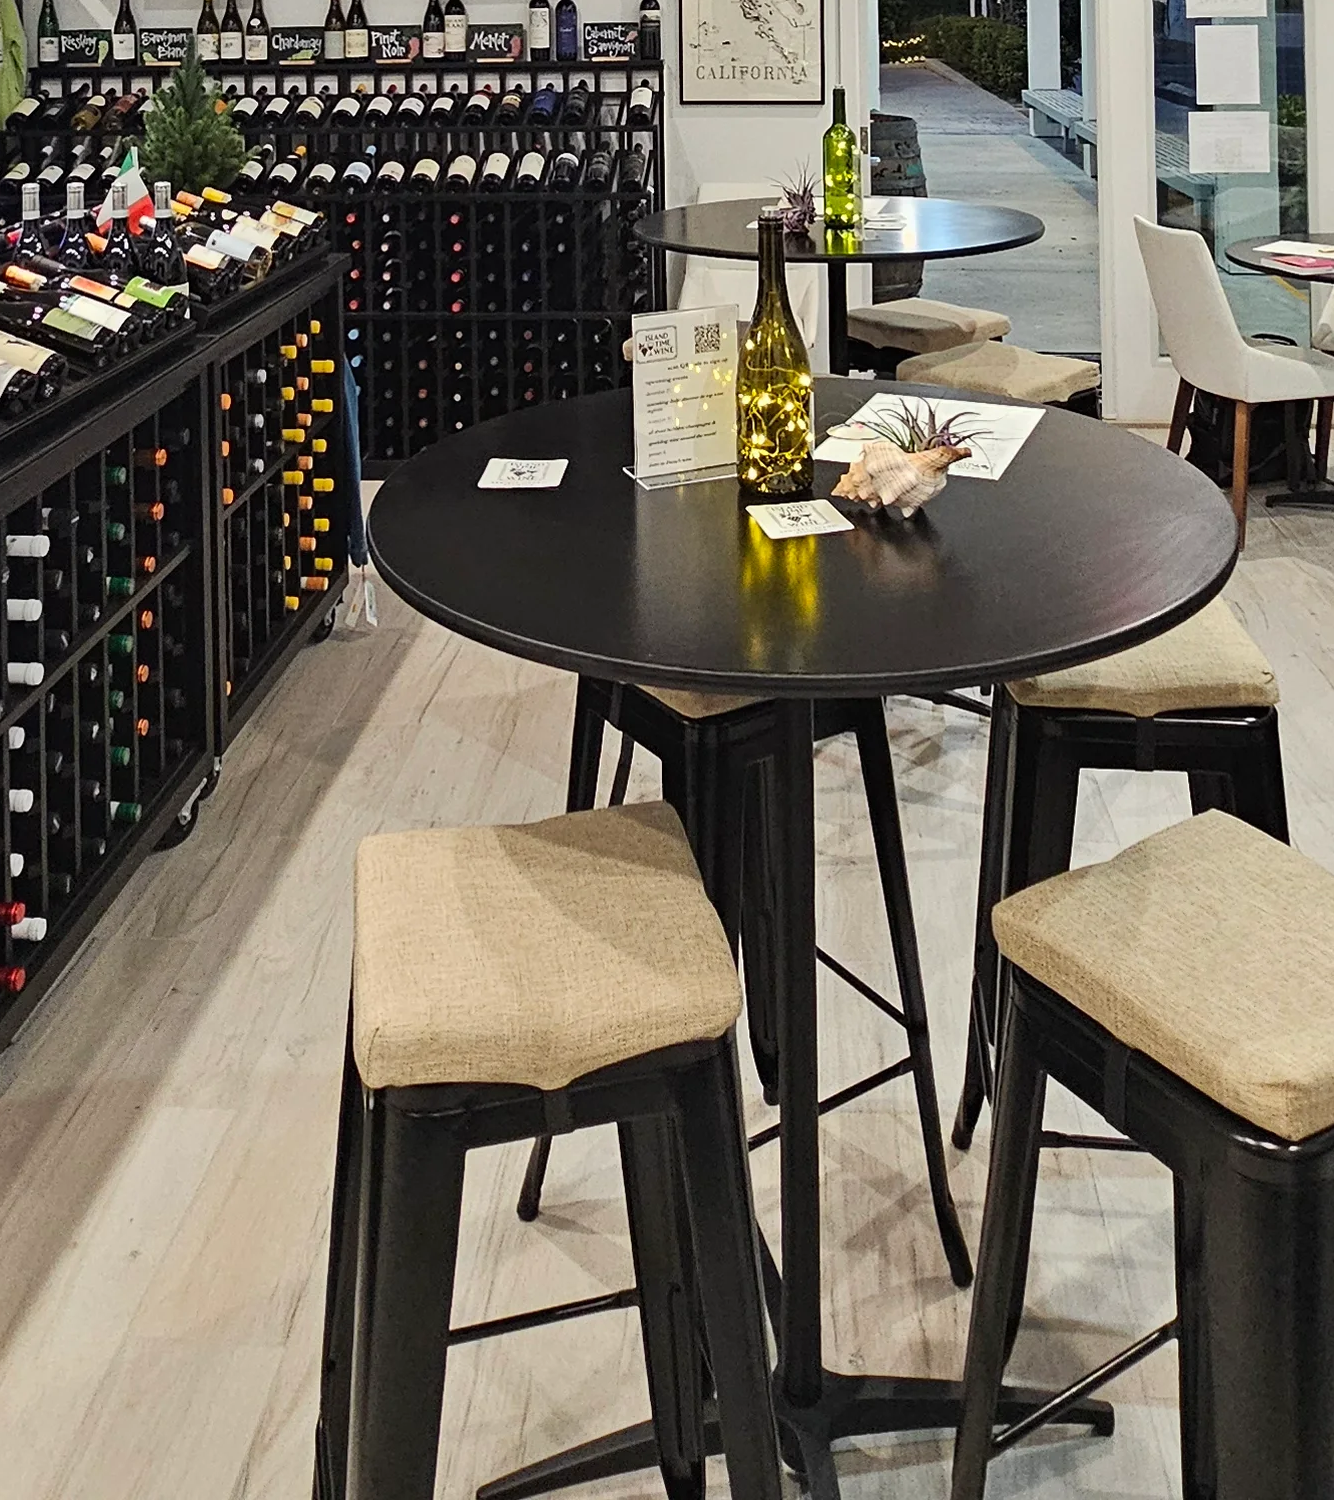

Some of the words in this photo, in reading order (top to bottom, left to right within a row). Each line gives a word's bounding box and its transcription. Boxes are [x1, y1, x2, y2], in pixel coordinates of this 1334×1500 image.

[141, 29, 189, 48] Sauvignon
[370, 29, 401, 47] Pinot
[469, 30, 510, 51] Merlot
[584, 25, 625, 40] Cabernet
[60, 33, 99, 60] Riesling
[157, 45, 187, 60] Blanc
[271, 33, 322, 55] Chardonnay
[381, 43, 406, 58] Noir
[587, 38, 636, 58] Sauvignon
[695, 64, 808, 82] CALIFORNIA
[645, 332, 669, 342] ISLAND
[654, 339, 670, 347] TIME
[653, 346, 674, 355] WINE
